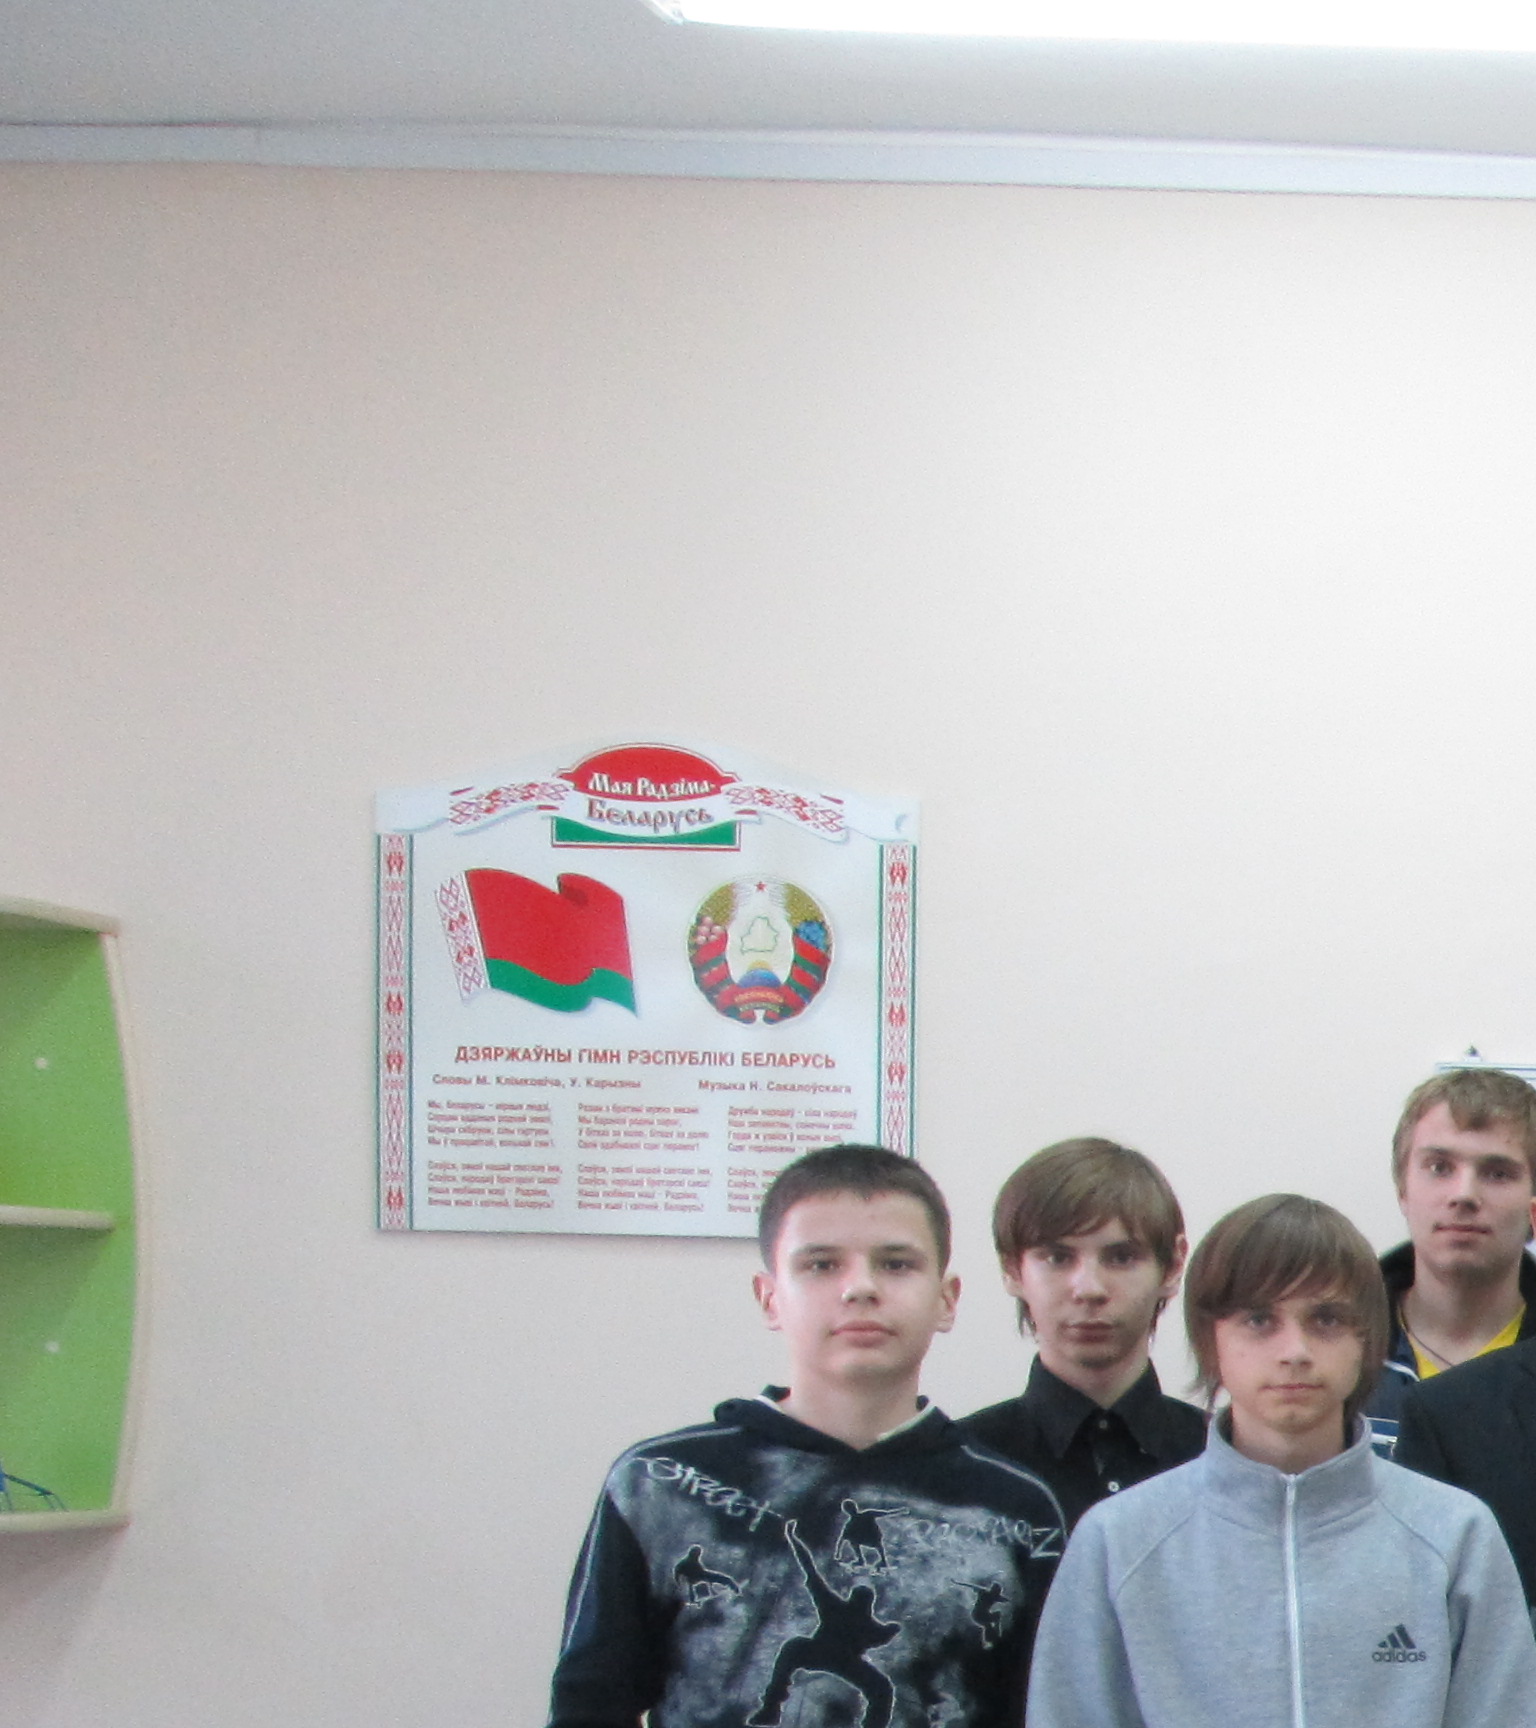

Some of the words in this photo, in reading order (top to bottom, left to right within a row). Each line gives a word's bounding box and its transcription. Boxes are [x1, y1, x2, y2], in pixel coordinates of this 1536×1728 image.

[588, 772, 633, 796] Мая
[587, 797, 714, 834] Беларусь
[454, 1044, 572, 1064] ДЗЯРЖАЎНЫ
[578, 1048, 621, 1064] ГІМН
[627, 1049, 735, 1067] РЭСПУБЛІКІ
[740, 1051, 836, 1069] БЕЛАРУСЬ
[698, 1079, 745, 1092] Музыка
[1371, 1649, 1427, 1663] adidas
